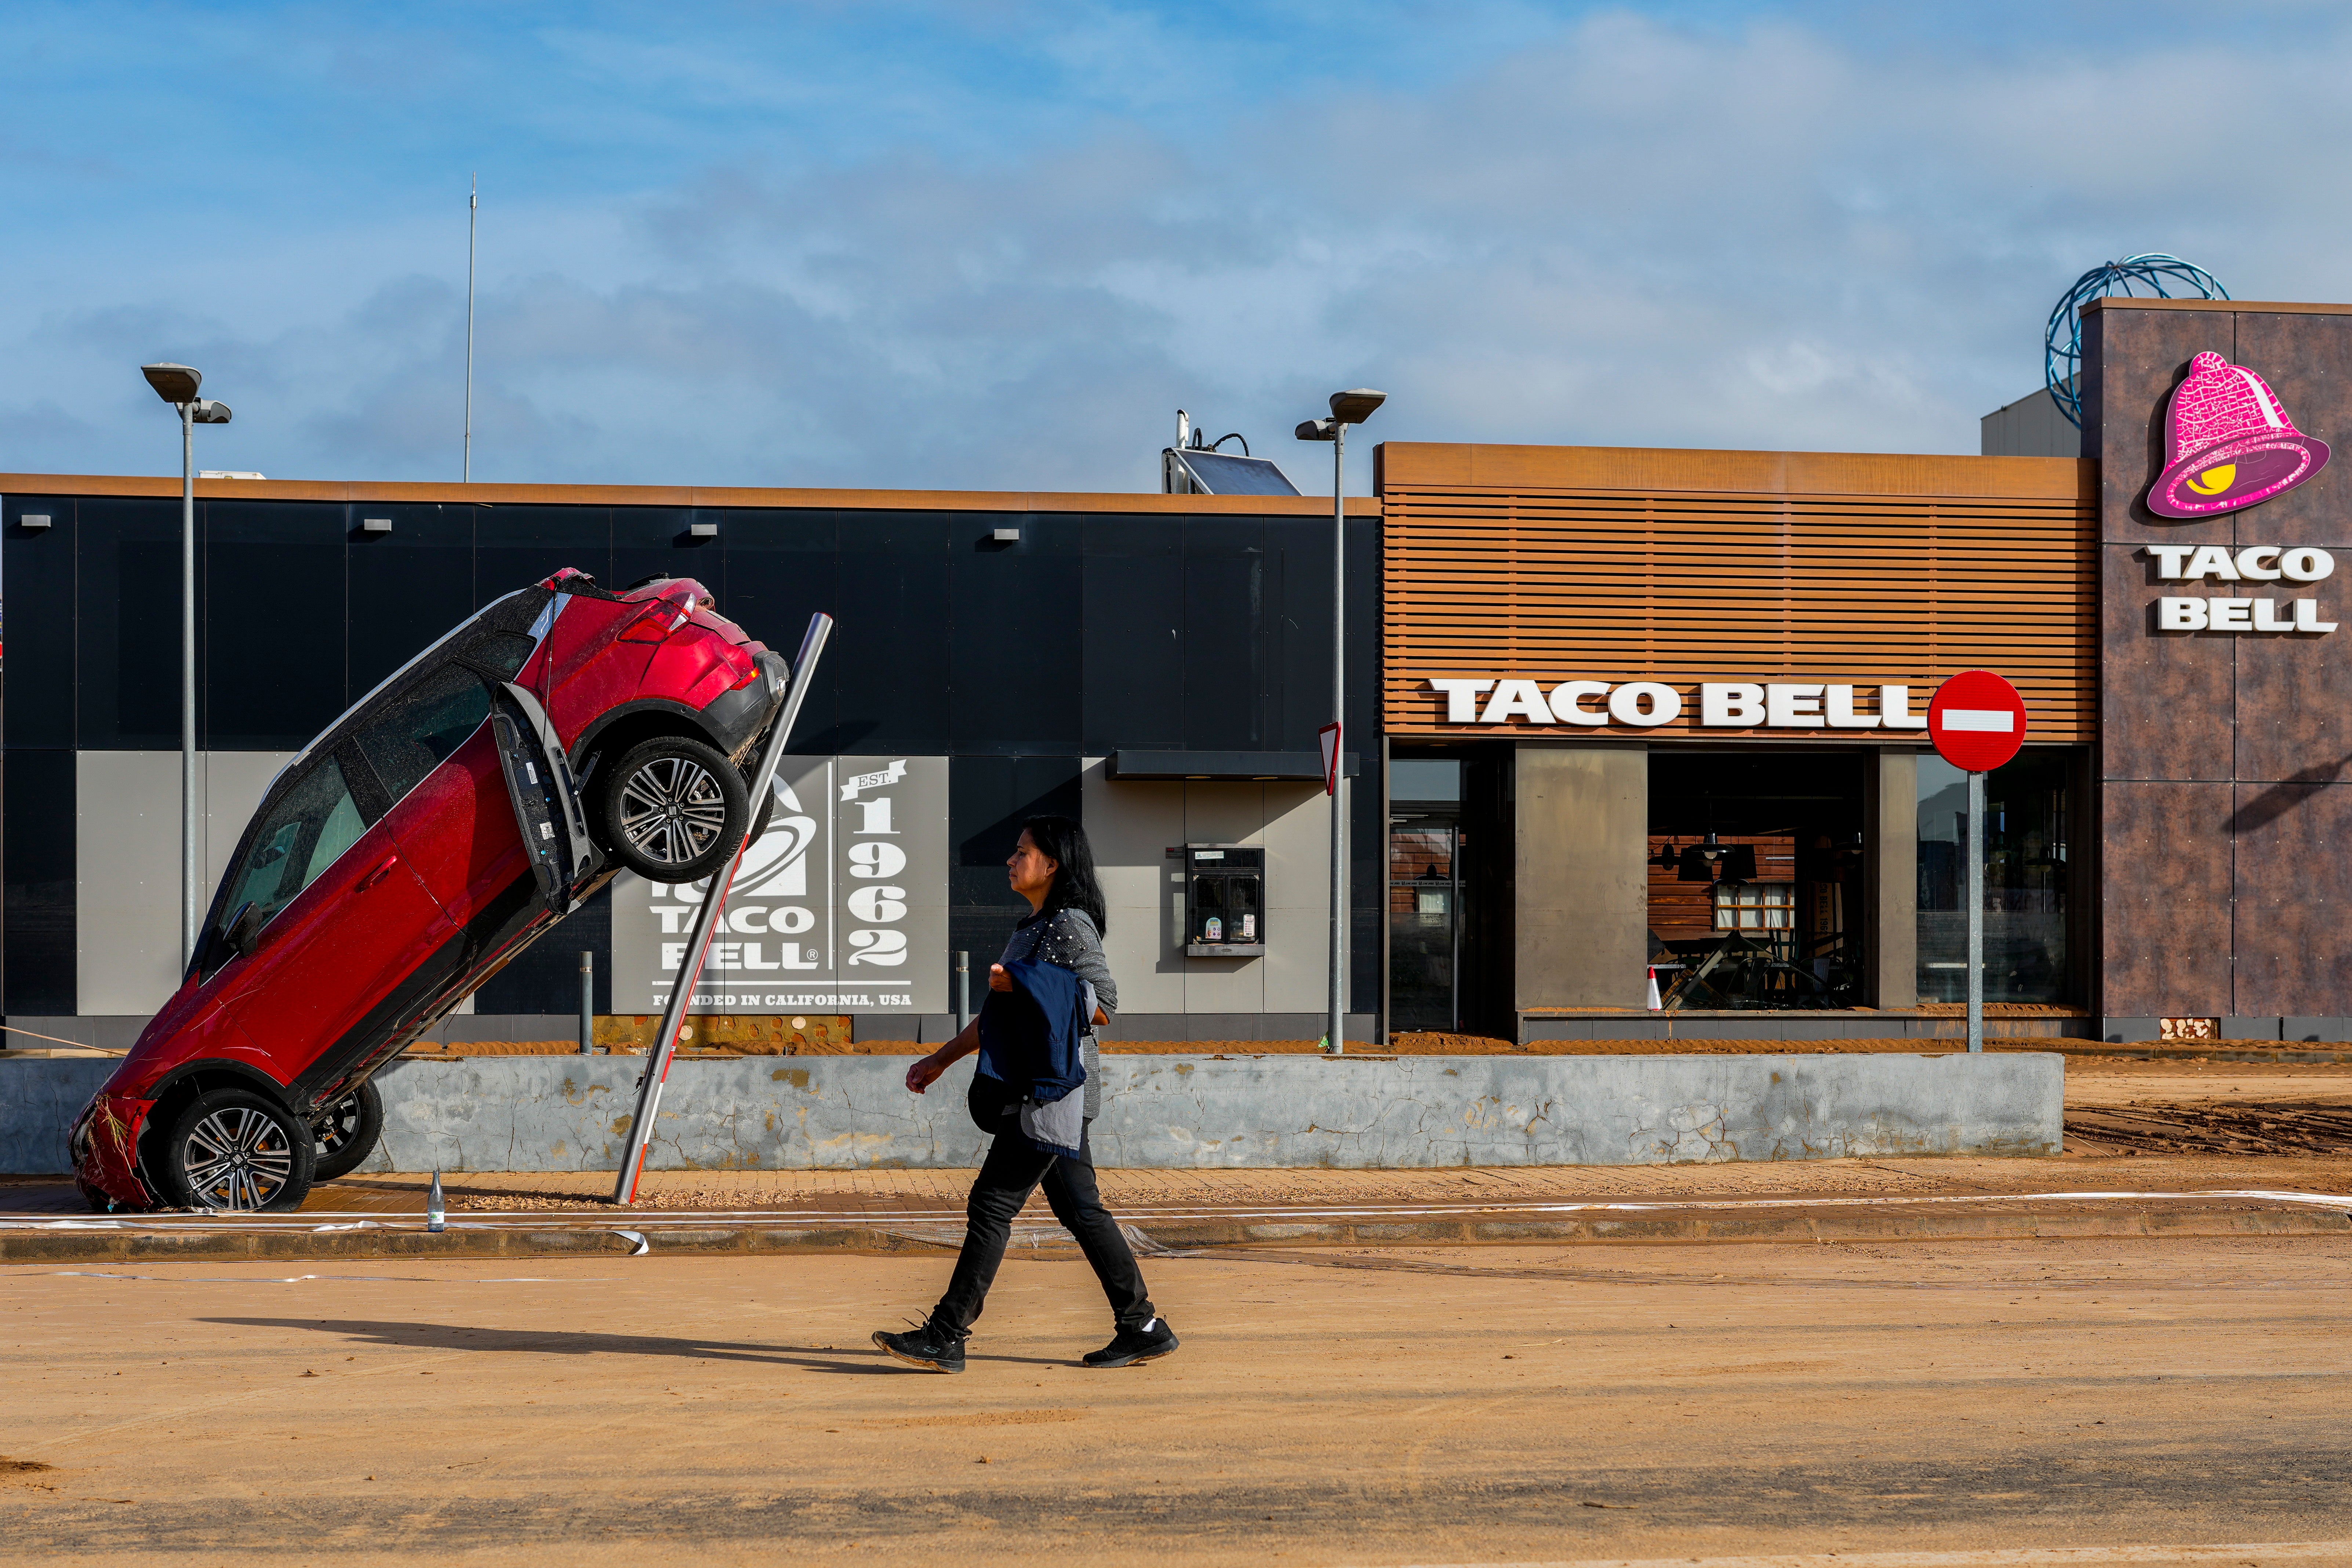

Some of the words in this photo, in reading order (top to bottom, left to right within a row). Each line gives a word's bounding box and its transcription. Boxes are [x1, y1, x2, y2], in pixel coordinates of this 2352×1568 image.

[2144, 545, 2334, 582] TACO
[2157, 596, 2339, 633] BELL
[1429, 679, 1682, 726] TACO
[1701, 682, 1928, 728] BELL
[857, 772, 891, 787] EST.
[848, 797, 907, 966] 1962
[1820, 896, 1828, 915] BELL
[653, 994, 737, 1006] FNDED
[741, 994, 761, 1006] IN
[765, 994, 874, 1007] CALIFORNIA,
[879, 994, 912, 1006] USA
